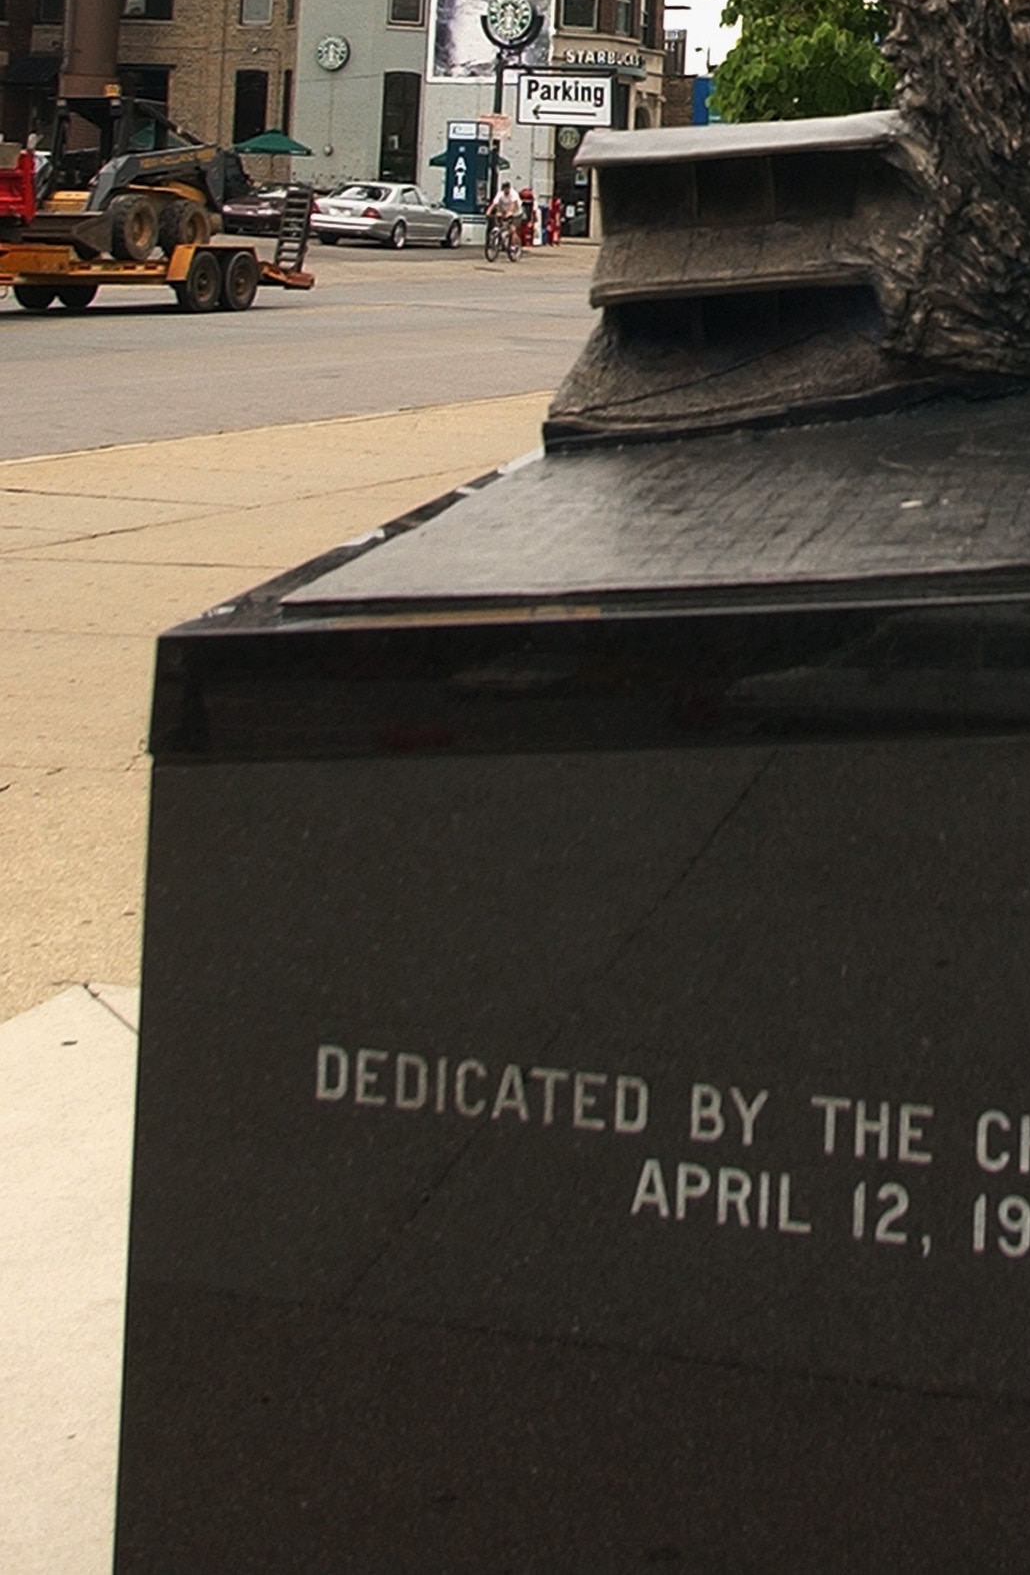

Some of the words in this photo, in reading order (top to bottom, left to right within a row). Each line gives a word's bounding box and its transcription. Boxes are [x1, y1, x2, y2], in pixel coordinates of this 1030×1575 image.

[527, 79, 605, 107] Parking
[452, 156, 467, 201] ATM
[315, 1045, 649, 1134] DEDICATED
[690, 1086, 768, 1147] BY
[811, 1095, 934, 1164] THE
[631, 1160, 811, 1233] APRIL
[850, 1183, 932, 1256] 12,
